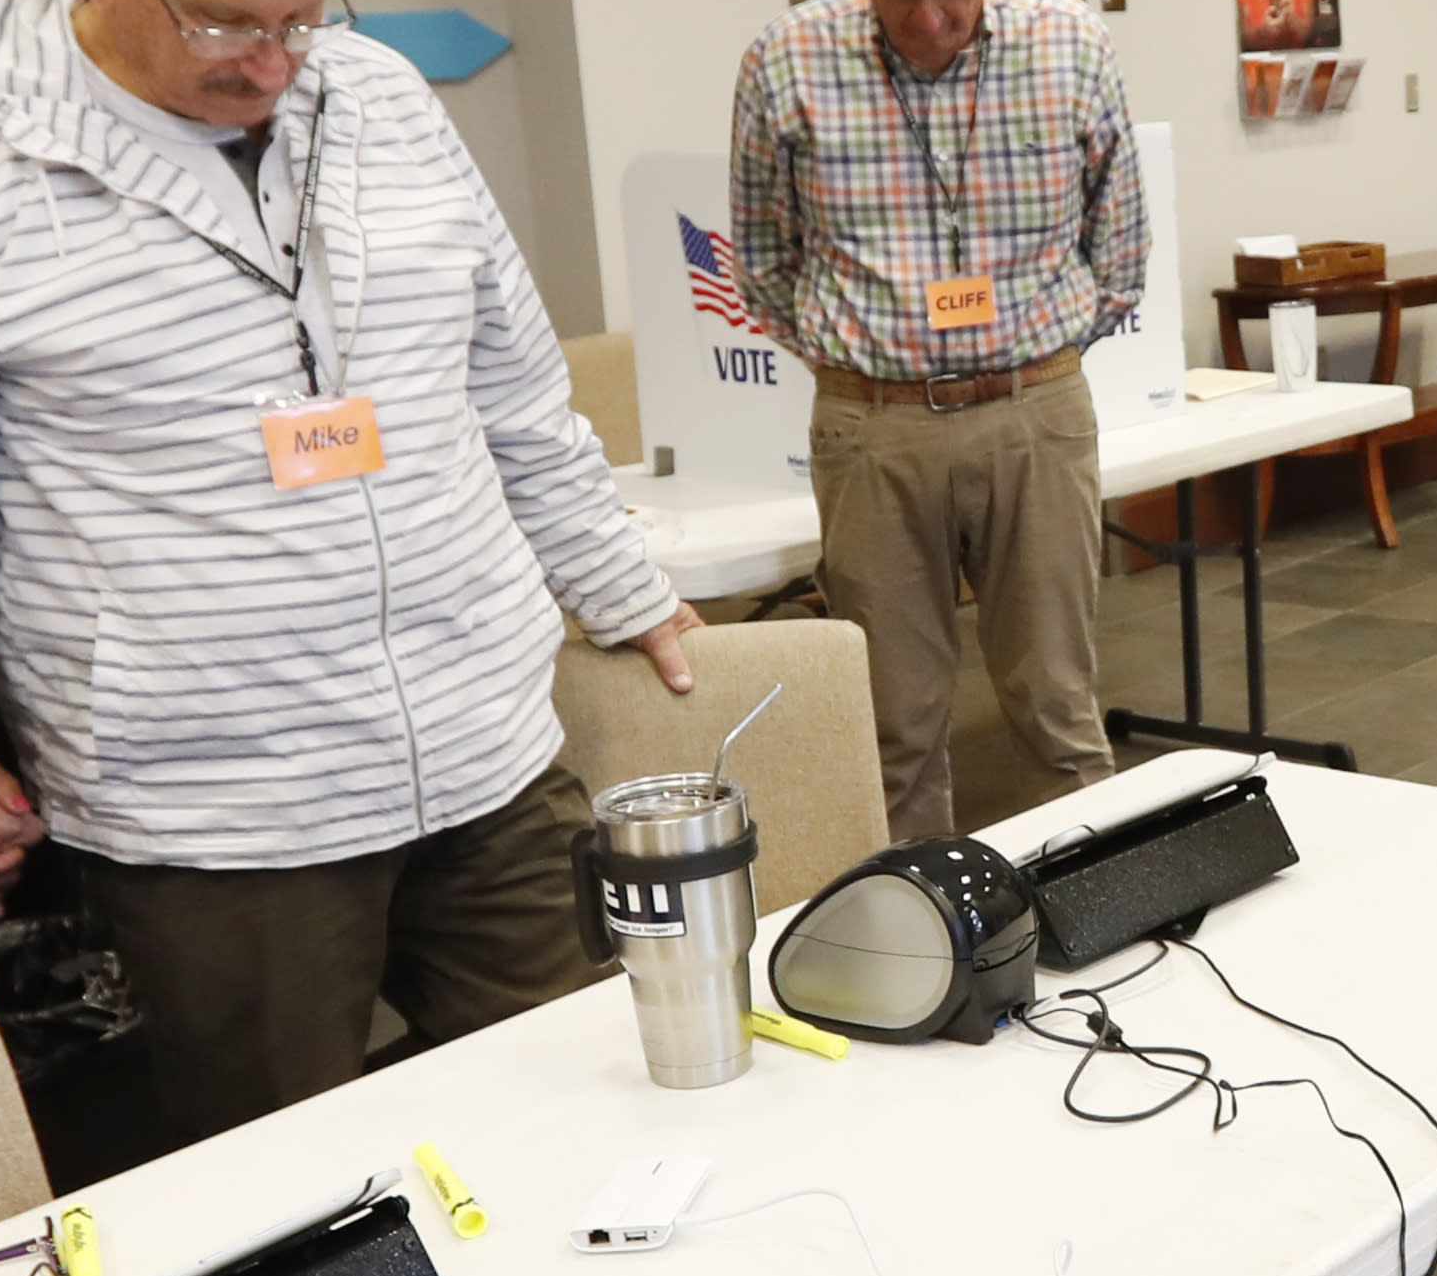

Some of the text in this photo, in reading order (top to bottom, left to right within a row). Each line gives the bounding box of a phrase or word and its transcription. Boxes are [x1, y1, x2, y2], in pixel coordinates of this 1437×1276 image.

[936, 290, 987, 311] CLIFF
[713, 345, 778, 386] VOTE
[294, 424, 360, 454] Mike
